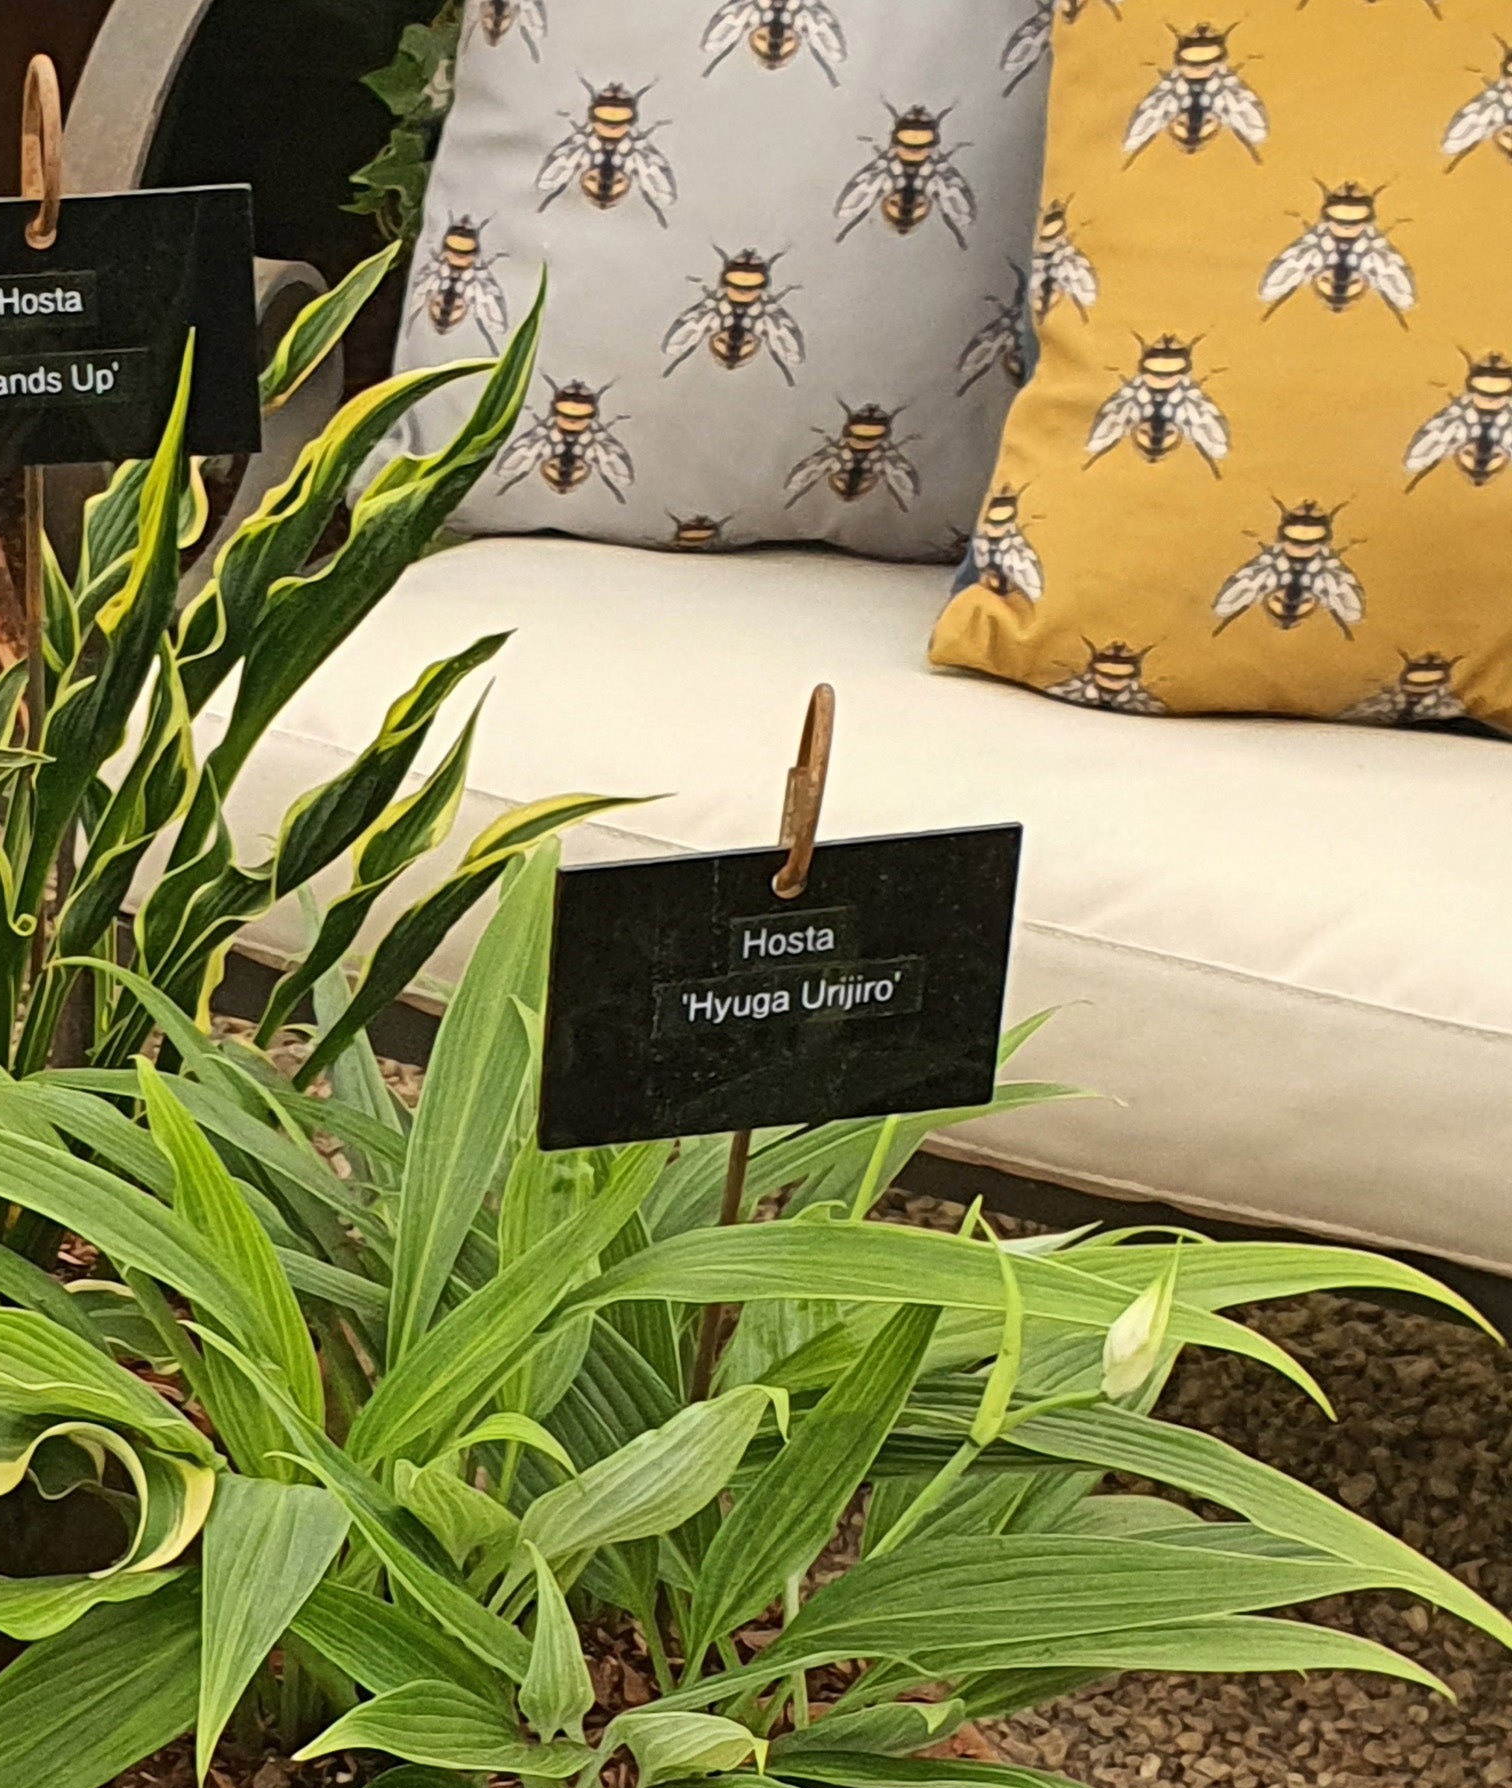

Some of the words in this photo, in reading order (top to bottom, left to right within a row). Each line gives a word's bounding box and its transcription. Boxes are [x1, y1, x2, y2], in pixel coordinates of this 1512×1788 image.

[71, 361, 119, 395] Up'
[743, 926, 835, 960] Hosta
[682, 990, 790, 1025] 'Hyuga
[801, 971, 902, 1011] Urijiro'
